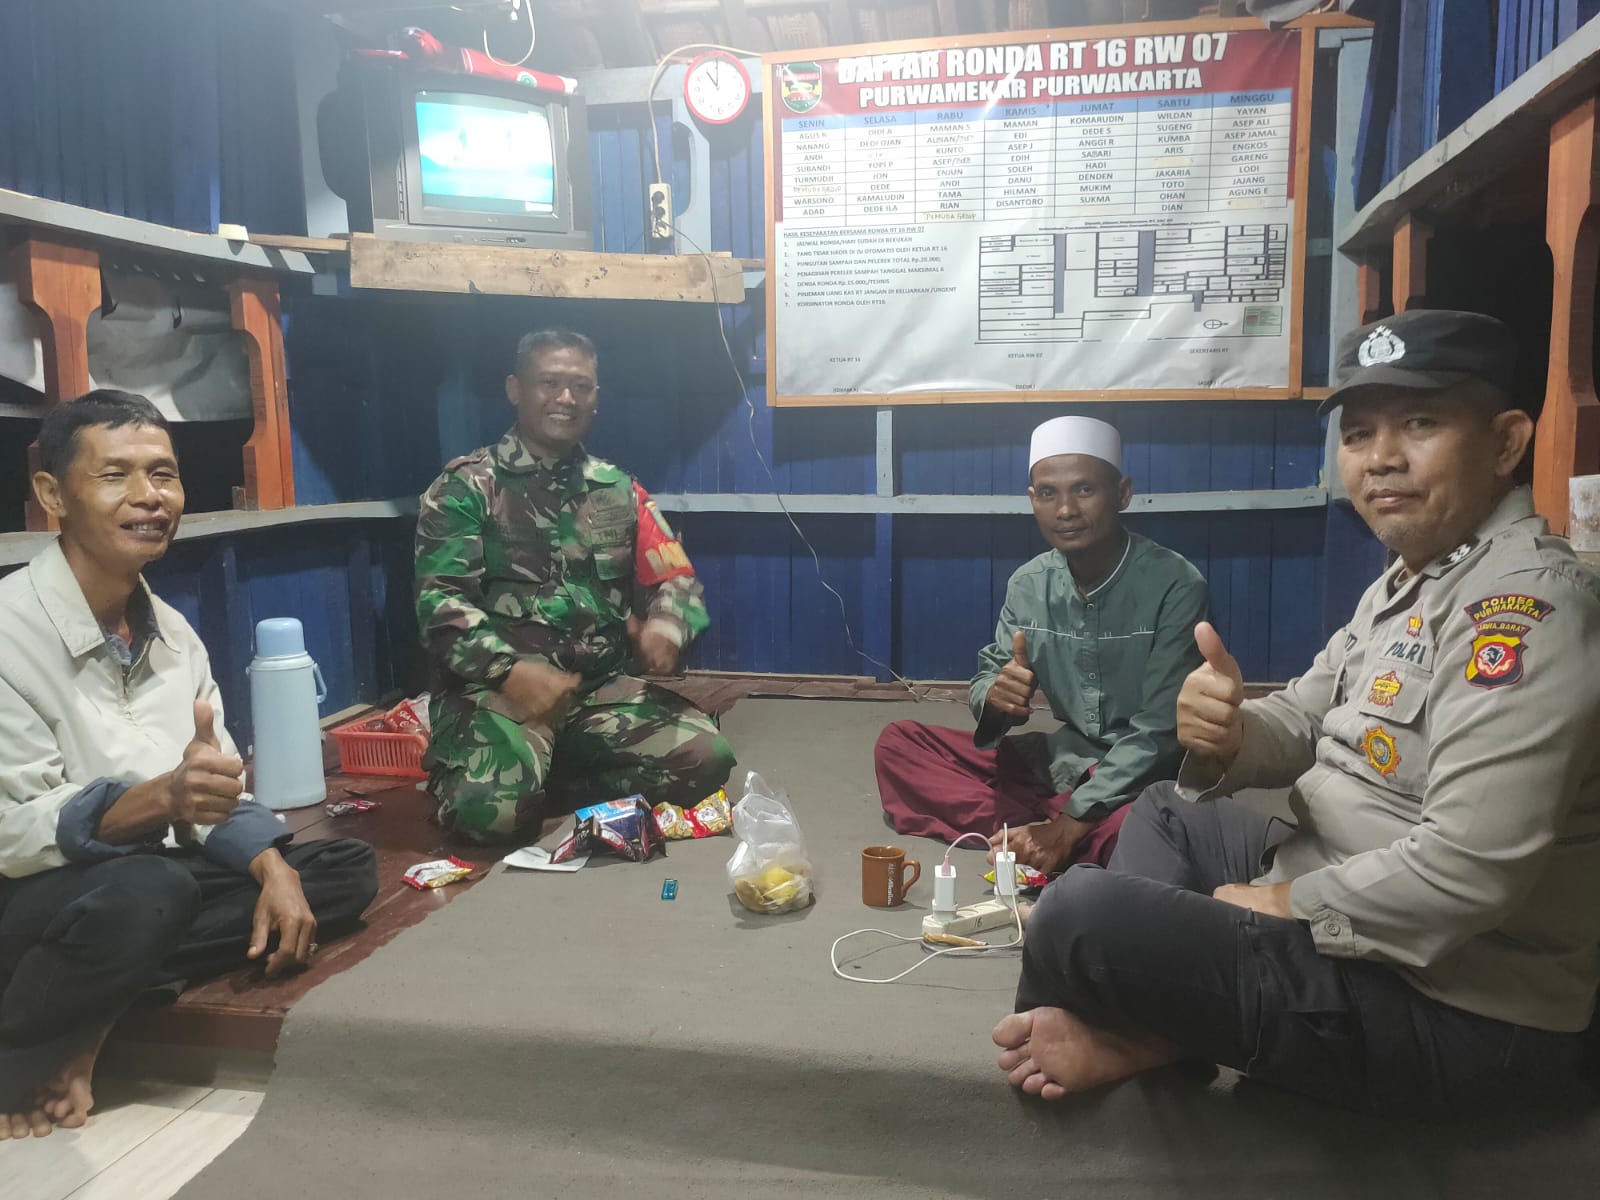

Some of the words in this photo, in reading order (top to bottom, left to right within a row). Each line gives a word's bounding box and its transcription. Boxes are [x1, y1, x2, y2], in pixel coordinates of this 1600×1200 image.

[837, 54, 939, 84] DAFTAR
[946, 45, 1043, 77] RONDA
[1050, 41, 1087, 71] RT
[1092, 38, 1127, 68] 16
[1134, 35, 1186, 66] RW
[1192, 32, 1229, 63] 07
[859, 77, 1027, 109] PURWAMEKAR
[1032, 67, 1203, 98] PURWAKARTA
[1158, 98, 1191, 107] SABTU
[1230, 94, 1274, 104] MINGGU
[1005, 107, 1037, 116] KAMIS
[1080, 103, 1114, 112] JUMAT
[1237, 107, 1267, 115] YAYAN
[863, 115, 897, 125] SELASA
[937, 112, 964, 121] RABU
[1070, 115, 1124, 125] KOMARUDIN
[1157, 112, 1193, 120] WILDAN
[798, 119, 825, 128] SENIN
[1003, 120, 1038, 128] MAMAN
[1232, 120, 1254, 128] ASEP
[1256, 118, 1270, 126] ALI
[930, 125, 965, 133] MAMAN
[1156, 123, 1193, 132] SUGENG
[1014, 132, 1027, 140] EDI
[1082, 128, 1105, 136] DEDE
[1224, 132, 1246, 140] ASEP
[1247, 129, 1278, 138] JAMAL
[1158, 134, 1191, 143] KUMBA
[796, 143, 830, 151] NANANG
[1007, 143, 1028, 151] ASEP
[1078, 139, 1108, 147] ANGGI
[1232, 141, 1269, 151] ENGKOS
[1163, 146, 1184, 154] ARIS
[1010, 154, 1030, 162] EDIH
[1231, 153, 1269, 162] GARENG
[796, 164, 831, 172] SUBANDI
[1007, 165, 1033, 173] SOLEH
[1239, 165, 1260, 173] LODI
[937, 169, 963, 177] ENJUN
[1078, 173, 1113, 181] DENDEN
[1155, 169, 1191, 178] JAKARIA
[1232, 177, 1265, 185] JAJANG
[870, 183, 891, 191] DEDE
[1003, 187, 1037, 195] HILMAN
[1079, 184, 1111, 192] MUKIM
[937, 191, 963, 199] TAMA
[1228, 187, 1262, 196] AGUNG
[856, 194, 905, 202] KAMALUDIN
[1079, 195, 1111, 203] SUKMA
[1159, 192, 1186, 200] OHAN
[793, 196, 835, 205] WARSONO
[863, 205, 884, 213] DEDE
[939, 202, 960, 210] RIAN
[803, 208, 825, 216] ADAD
[1481, 596, 1536, 610] POLRES
[1473, 603, 1541, 621] PURWAKARTA
[1499, 623, 1526, 633] BARAT
